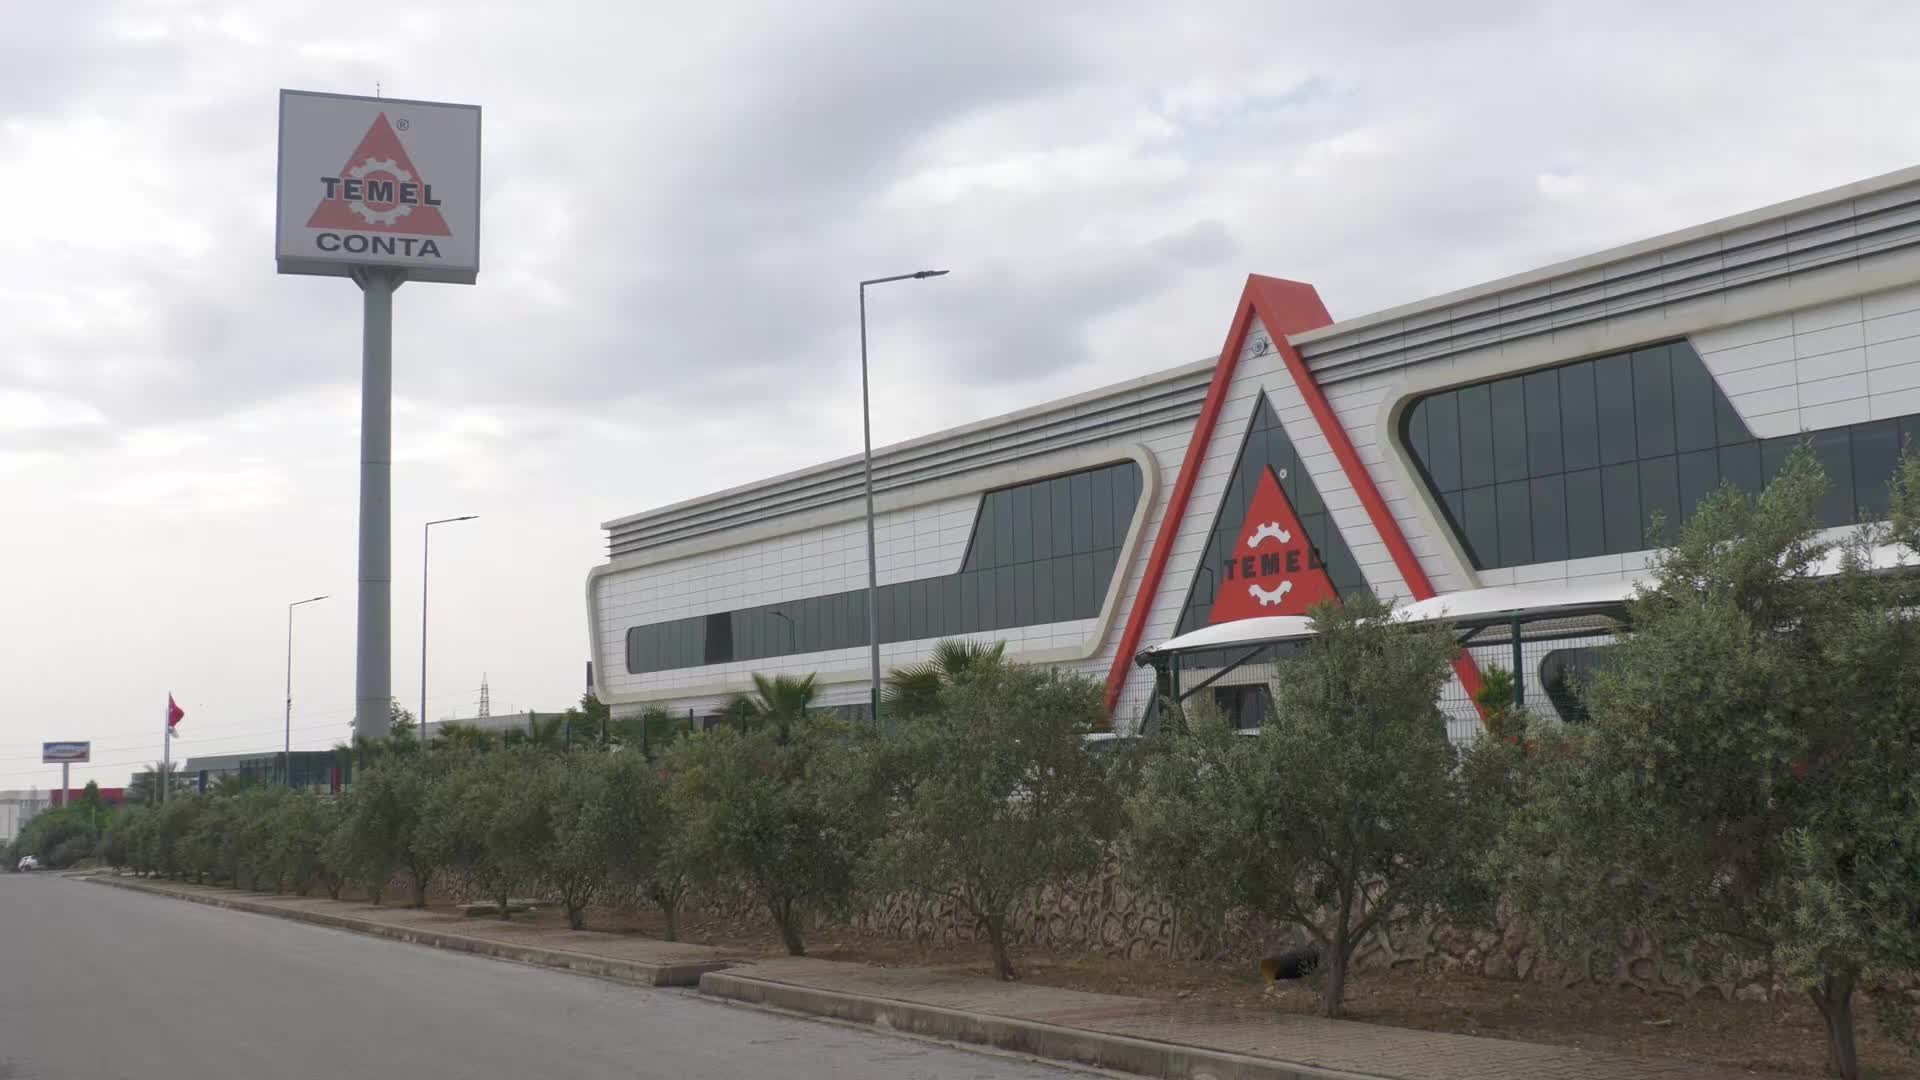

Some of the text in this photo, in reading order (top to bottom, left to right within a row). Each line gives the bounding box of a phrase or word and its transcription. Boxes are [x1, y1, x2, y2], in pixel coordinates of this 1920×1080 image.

[320, 177, 442, 206] TEMEL
[316, 233, 441, 258] CONTA
[1224, 547, 1327, 580] TEMEL
